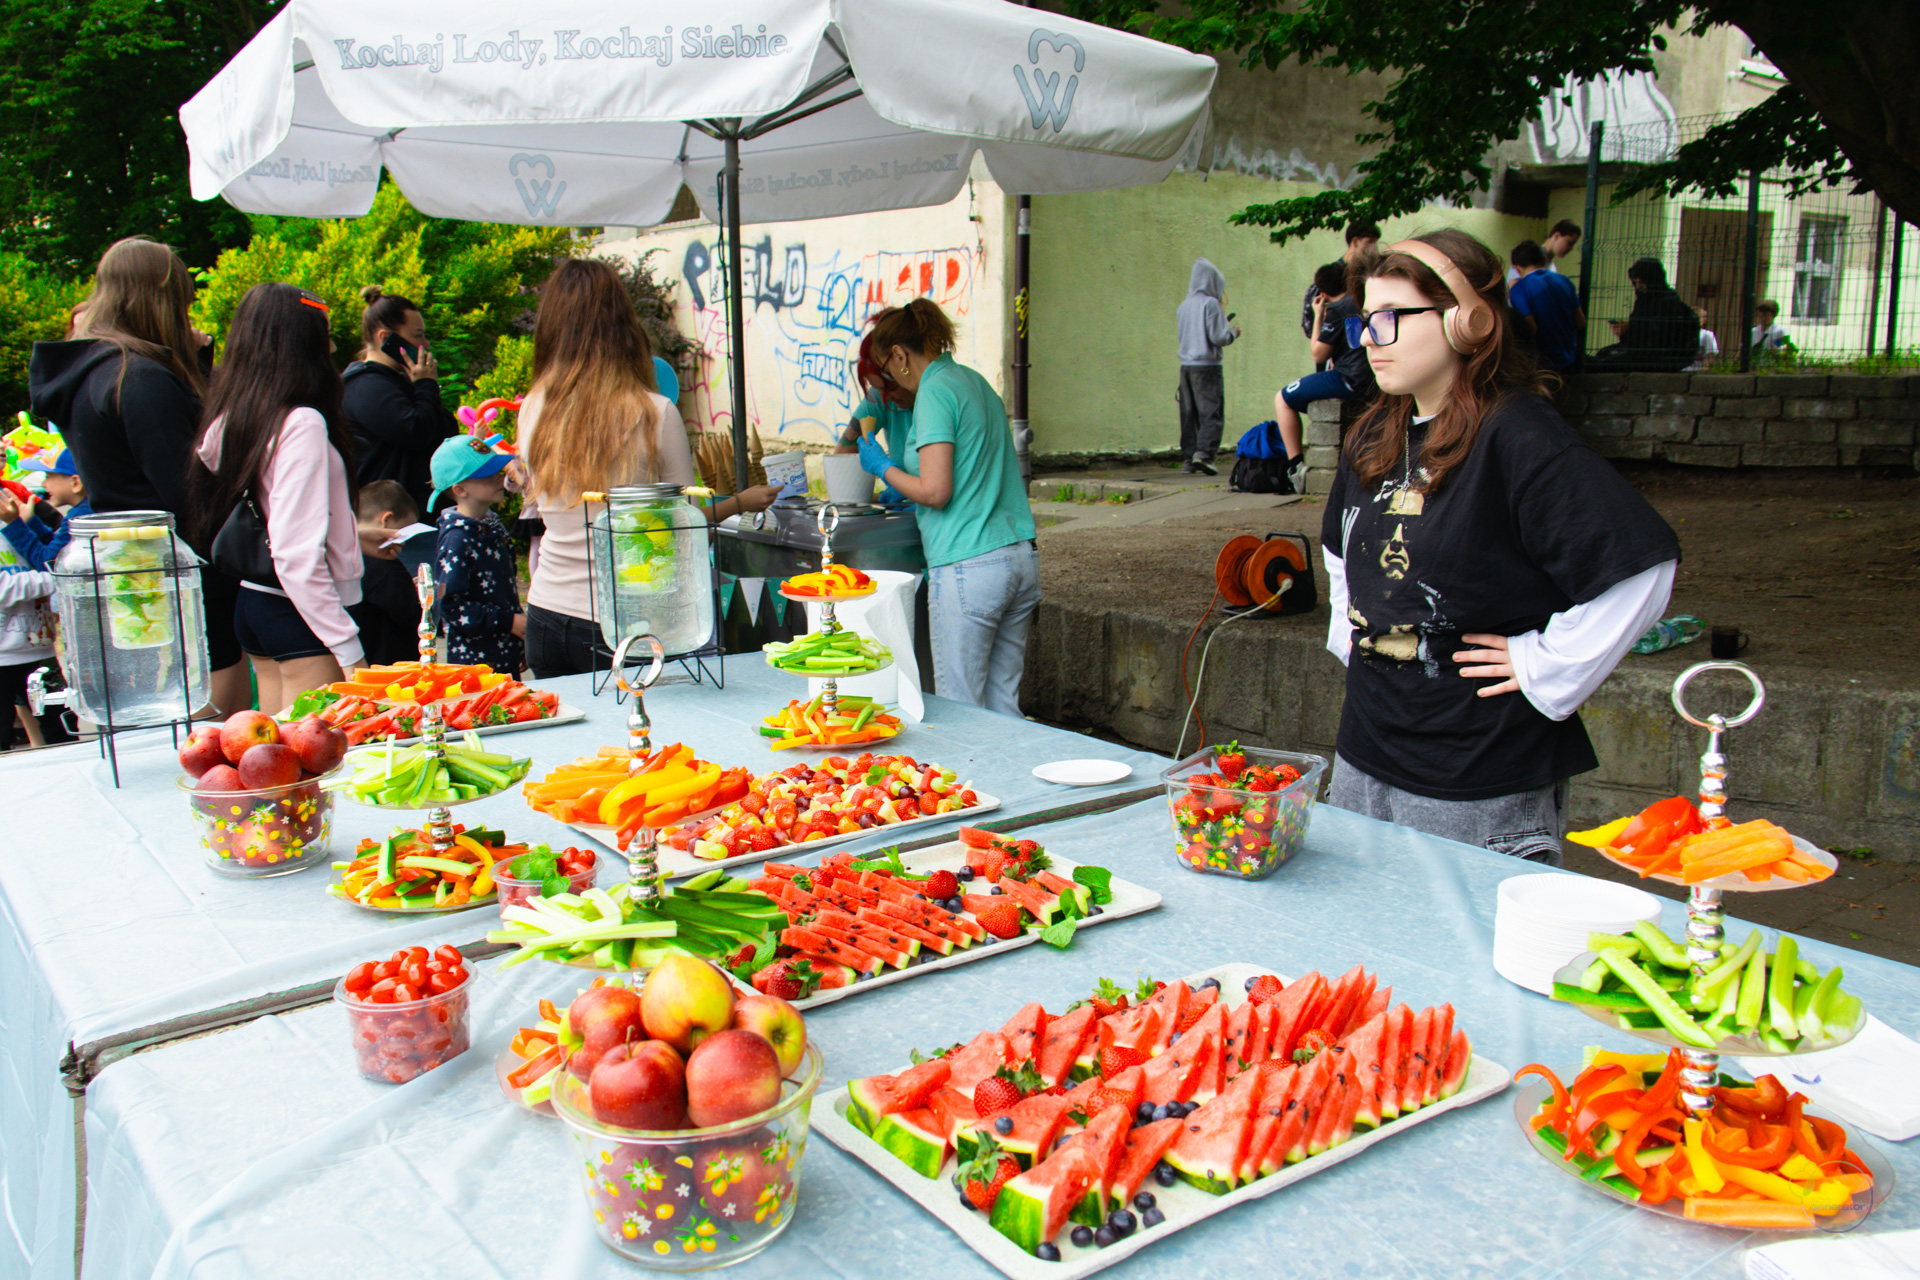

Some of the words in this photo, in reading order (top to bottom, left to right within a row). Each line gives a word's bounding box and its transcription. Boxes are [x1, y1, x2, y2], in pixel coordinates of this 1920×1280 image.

[334, 32, 444, 73] Kochaj
[453, 29, 547, 70] Lody,
[554, 25, 673, 67] Kochaj
